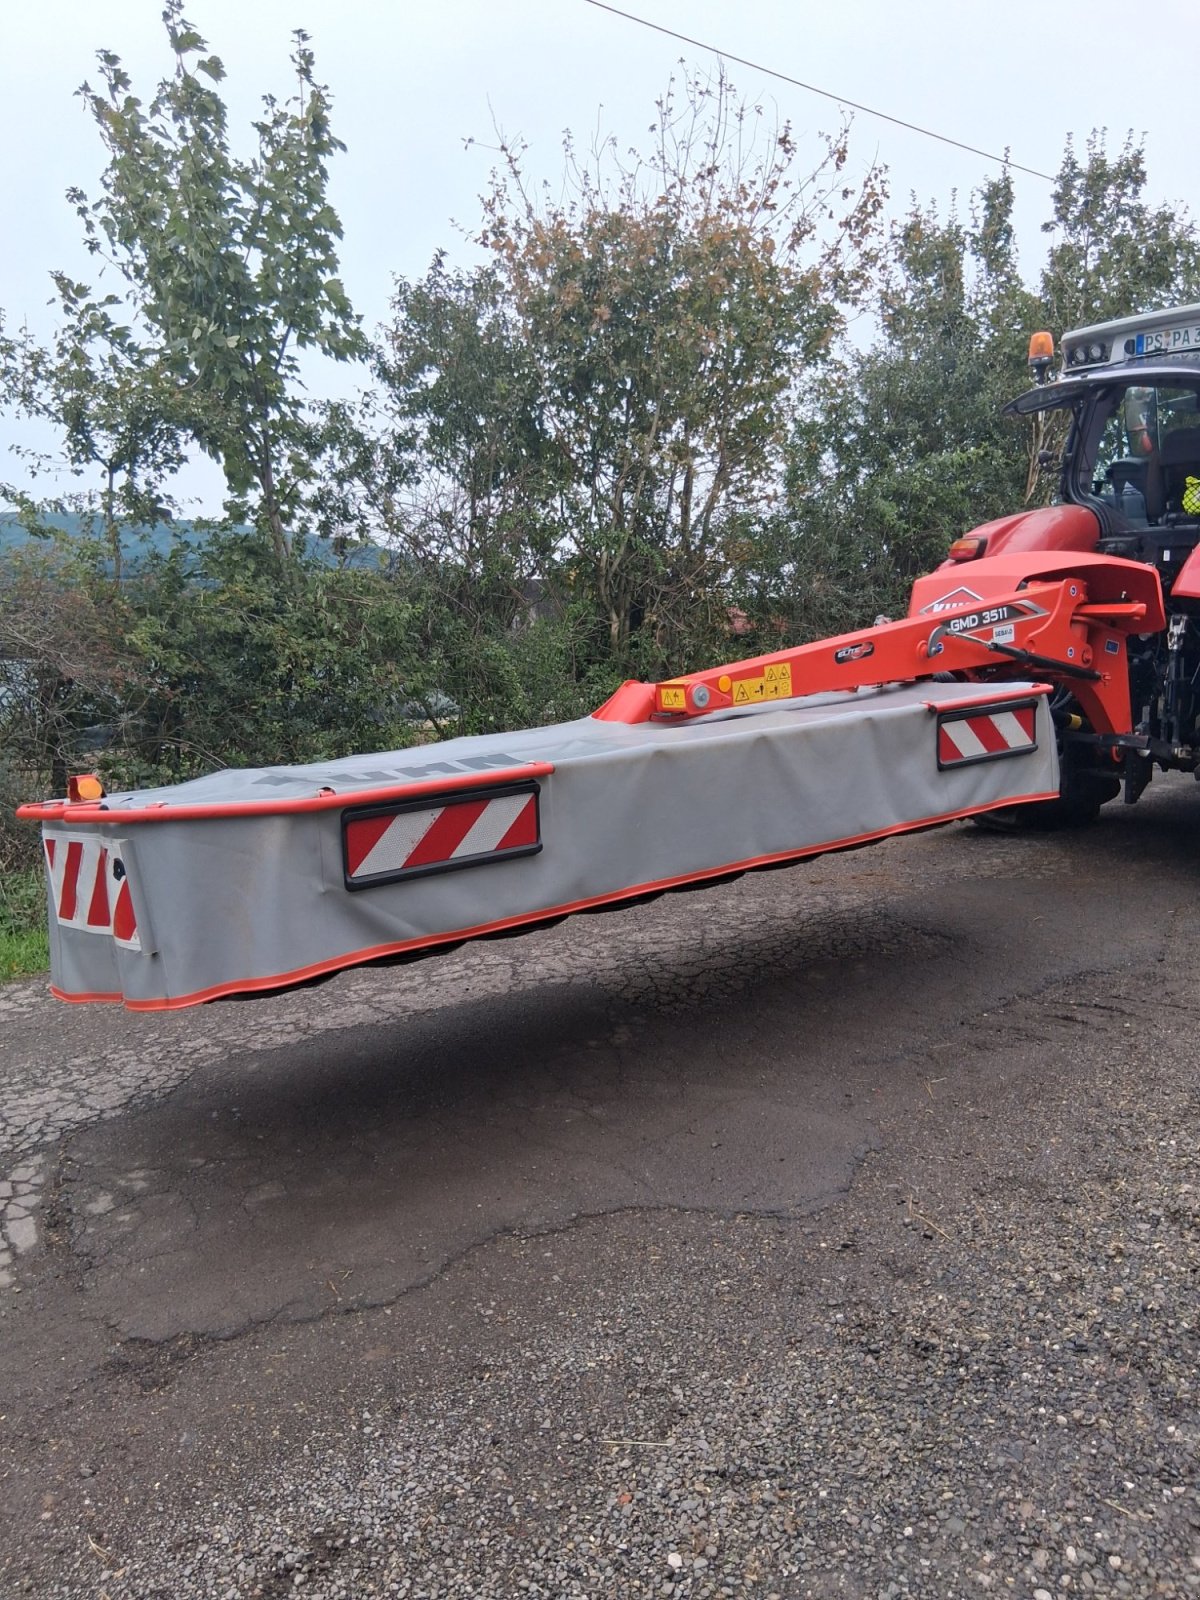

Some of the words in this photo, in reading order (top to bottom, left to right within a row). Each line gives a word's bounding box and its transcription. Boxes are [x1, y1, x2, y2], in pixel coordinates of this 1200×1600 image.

[1145, 333, 1163, 350] PS
[1172, 329, 1190, 346] PA
[950, 614, 979, 632] GMD
[982, 607, 1009, 624] 3511
